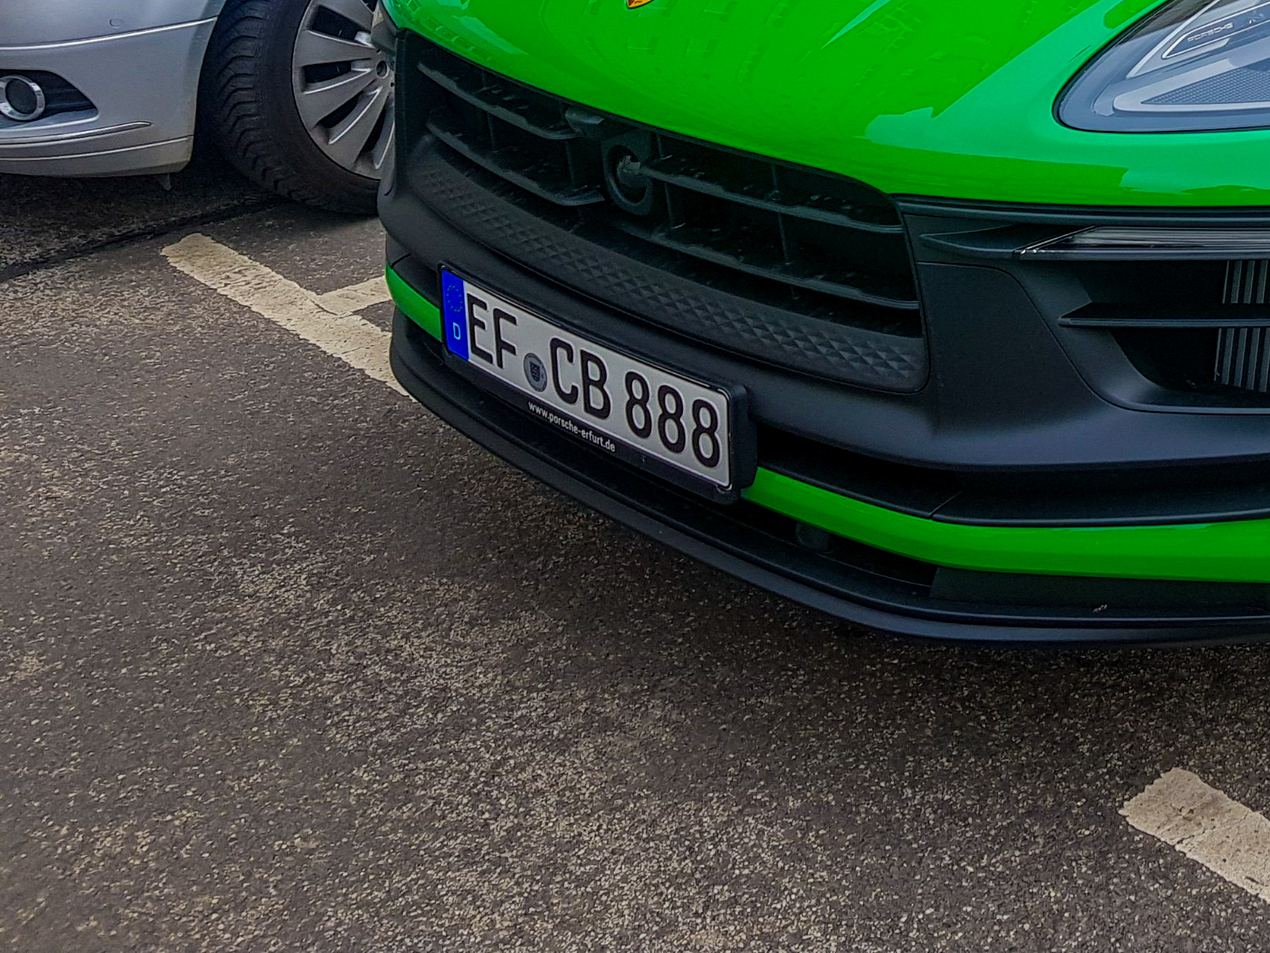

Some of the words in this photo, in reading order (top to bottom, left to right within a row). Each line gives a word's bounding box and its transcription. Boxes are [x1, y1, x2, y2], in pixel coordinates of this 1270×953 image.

[453, 321, 461, 341] D
[466, 293, 517, 369] EF
[550, 337, 611, 420] CB
[625, 371, 721, 468] 888
[528, 401, 616, 452] www.porsche-erfurt.de
